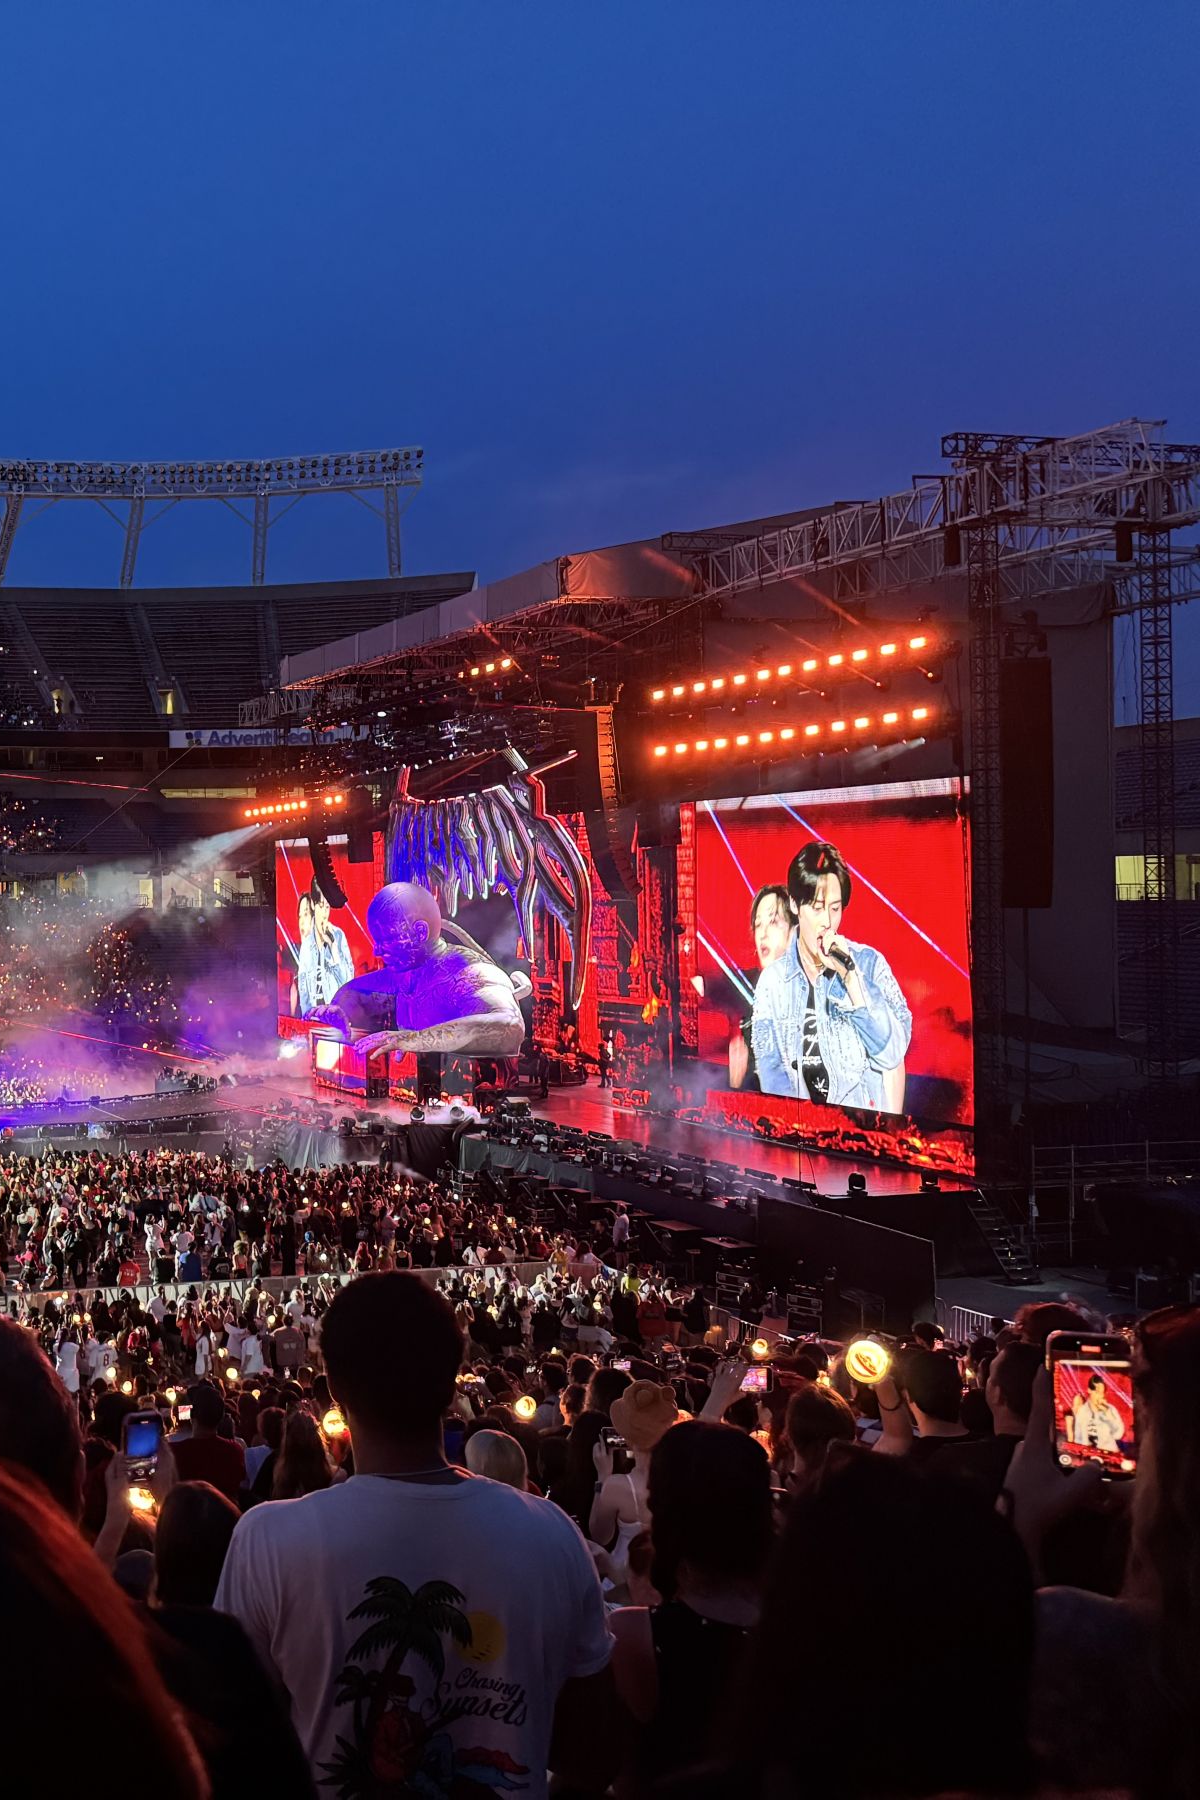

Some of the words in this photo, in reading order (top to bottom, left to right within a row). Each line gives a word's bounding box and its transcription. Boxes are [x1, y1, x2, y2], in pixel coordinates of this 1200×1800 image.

[208, 730, 335, 746] AdventHeah
[103, 1353, 110, 1367] 8
[455, 1667, 521, 1702] Chasing
[420, 1682, 528, 1727] Sunsets
